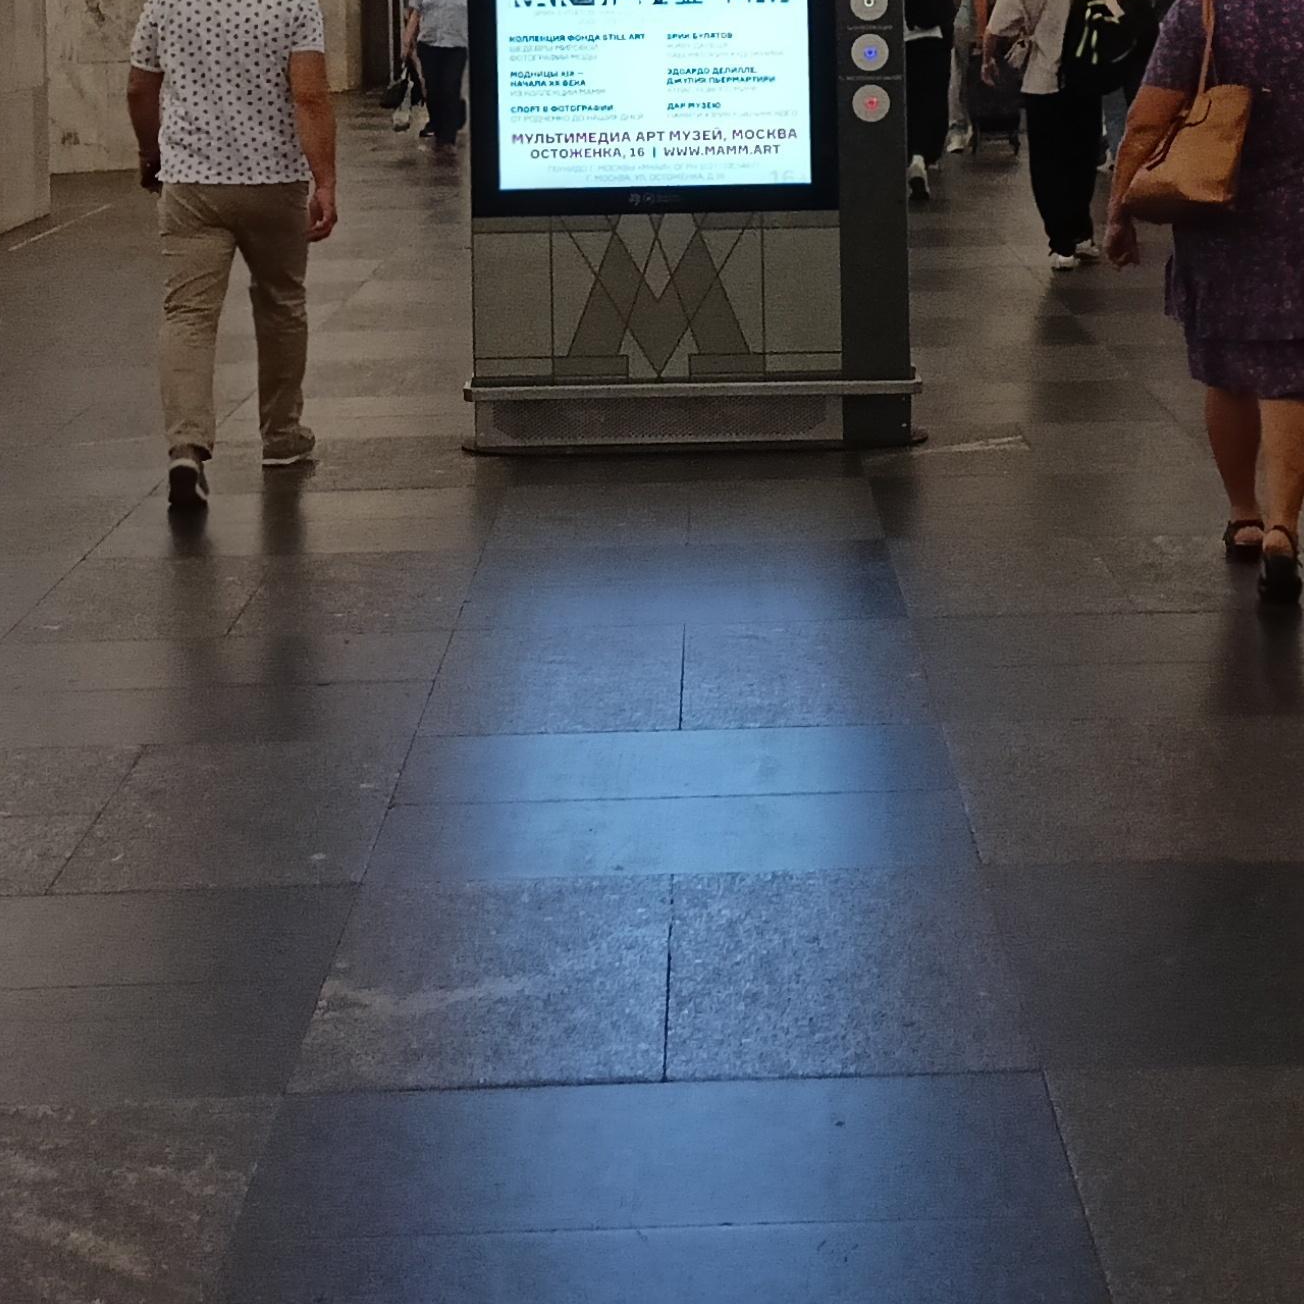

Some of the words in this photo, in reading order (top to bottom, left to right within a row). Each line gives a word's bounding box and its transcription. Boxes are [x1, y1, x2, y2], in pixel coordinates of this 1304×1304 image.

[512, 131, 631, 144] МУЛЬТИМЕДИА
[636, 131, 667, 142] АРТ
[669, 128, 727, 142] МУЗЕЙ,
[732, 128, 798, 140] МОСКВА
[530, 148, 625, 160] ОСТОЖЕНКА,
[629, 147, 645, 157] 16
[664, 145, 781, 156] WWW.MAMM.ART
